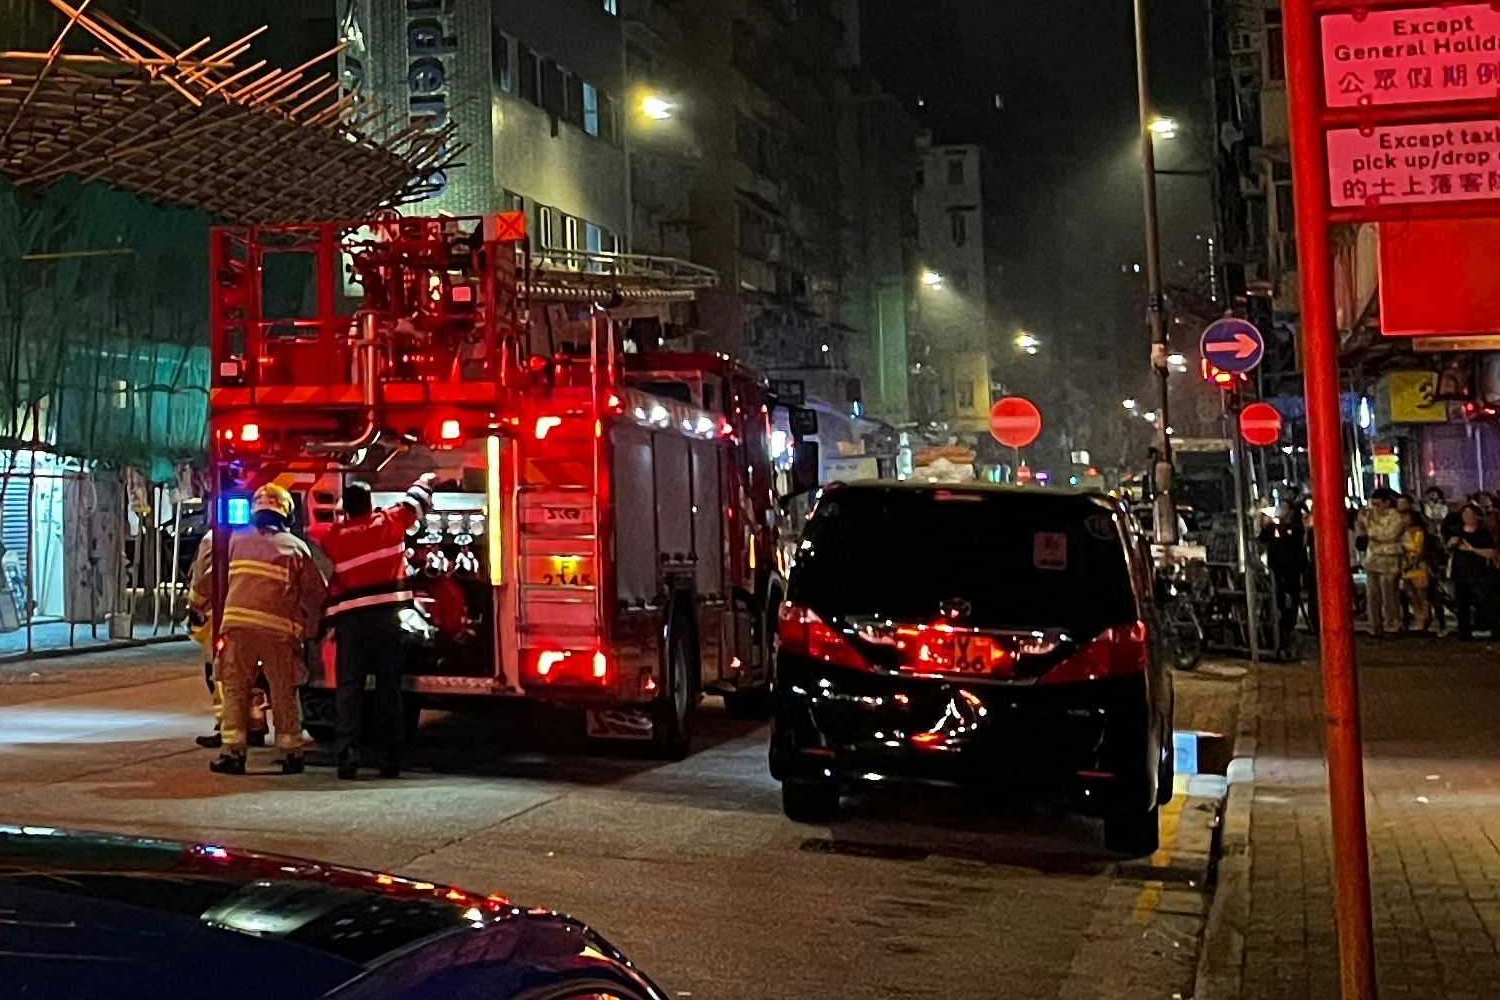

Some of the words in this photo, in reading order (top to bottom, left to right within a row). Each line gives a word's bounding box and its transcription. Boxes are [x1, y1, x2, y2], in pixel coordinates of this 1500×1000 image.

[1393, 15, 1475, 36] Except
[1334, 40, 1426, 61] General
[1433, 35, 1500, 54] Holid
[1380, 129, 1454, 149] Except
[1352, 153, 1397, 173] pick
[1404, 150, 1490, 170] up/drop
